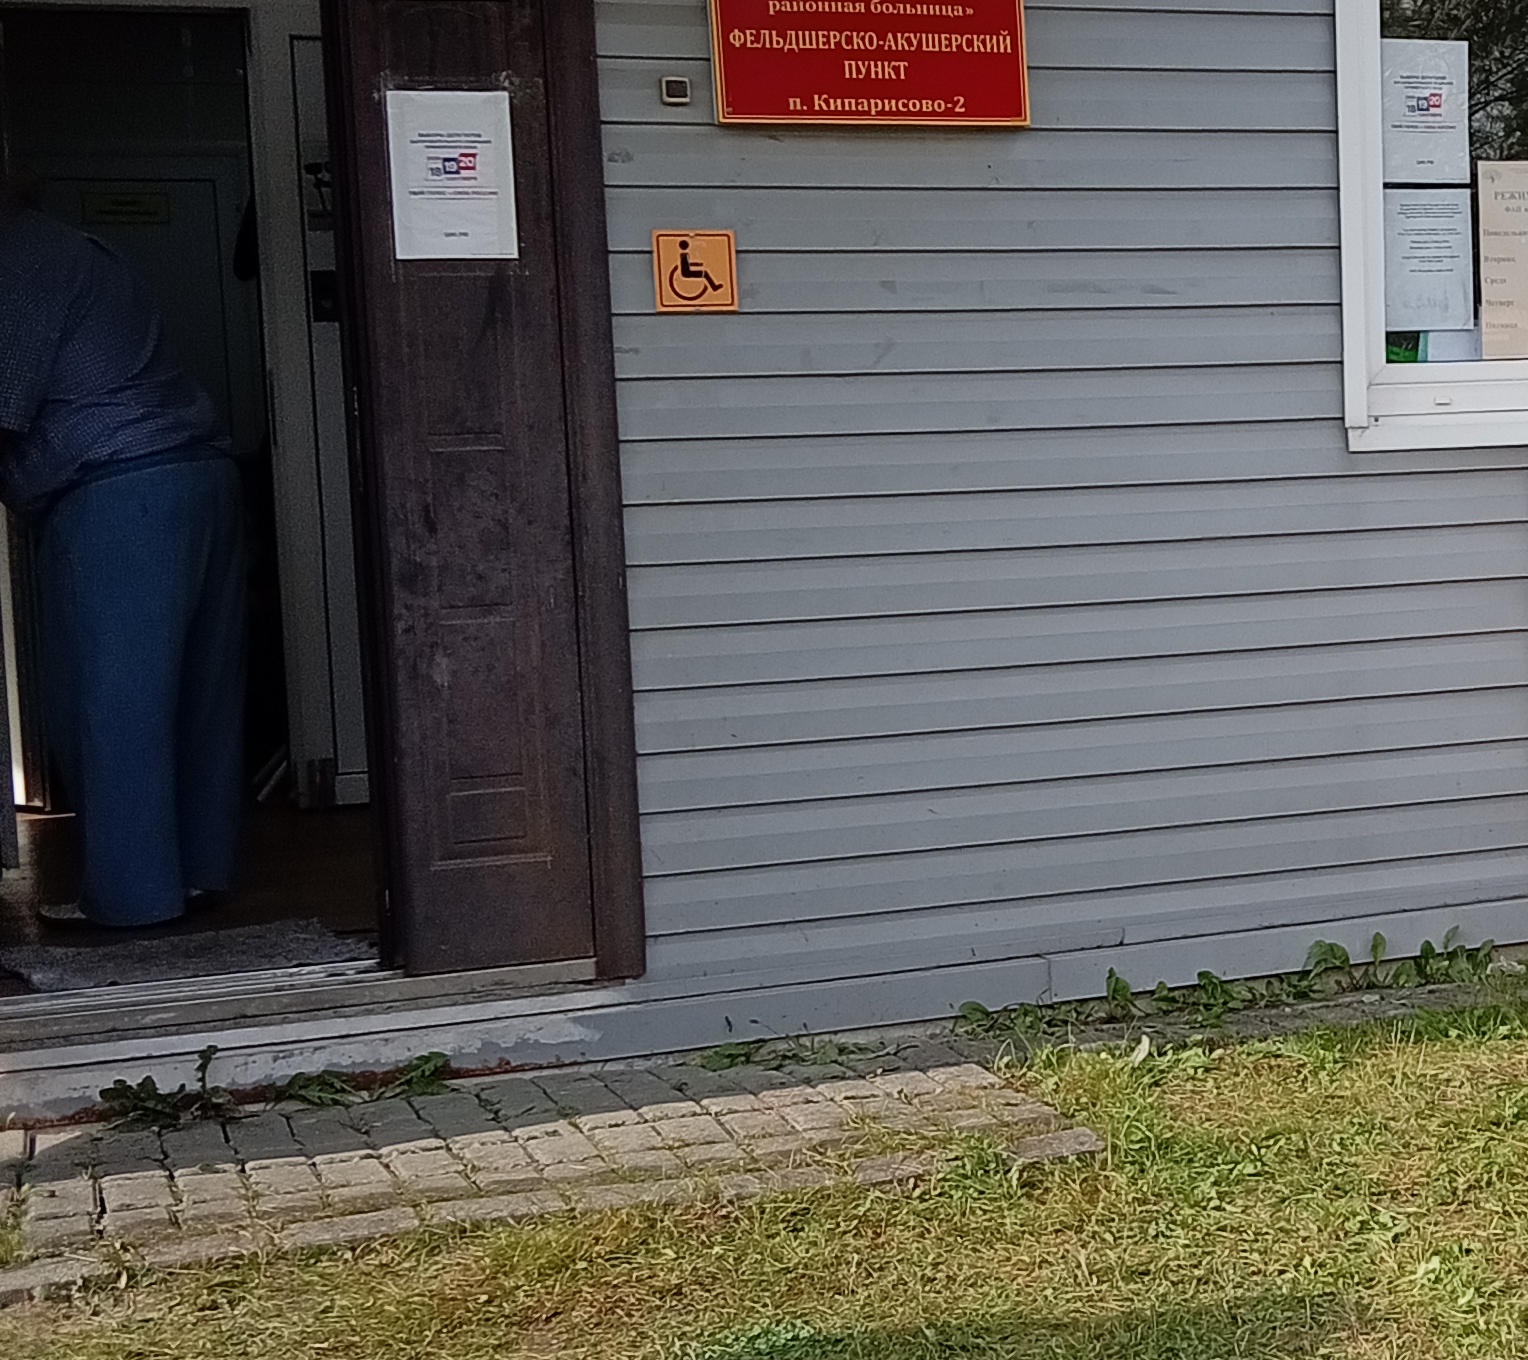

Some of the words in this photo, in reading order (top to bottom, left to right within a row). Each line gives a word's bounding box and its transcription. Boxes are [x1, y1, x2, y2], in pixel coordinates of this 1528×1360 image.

[870, 0, 974, 18] больница»
[729, 28, 1012, 53] ФЕЛЬДШЕРСКО-АКУШЕРСКИЙ
[843, 60, 909, 80] ПУНКТ
[789, 96, 808, 111] п.
[813, 94, 966, 115] Кипарисово-2
